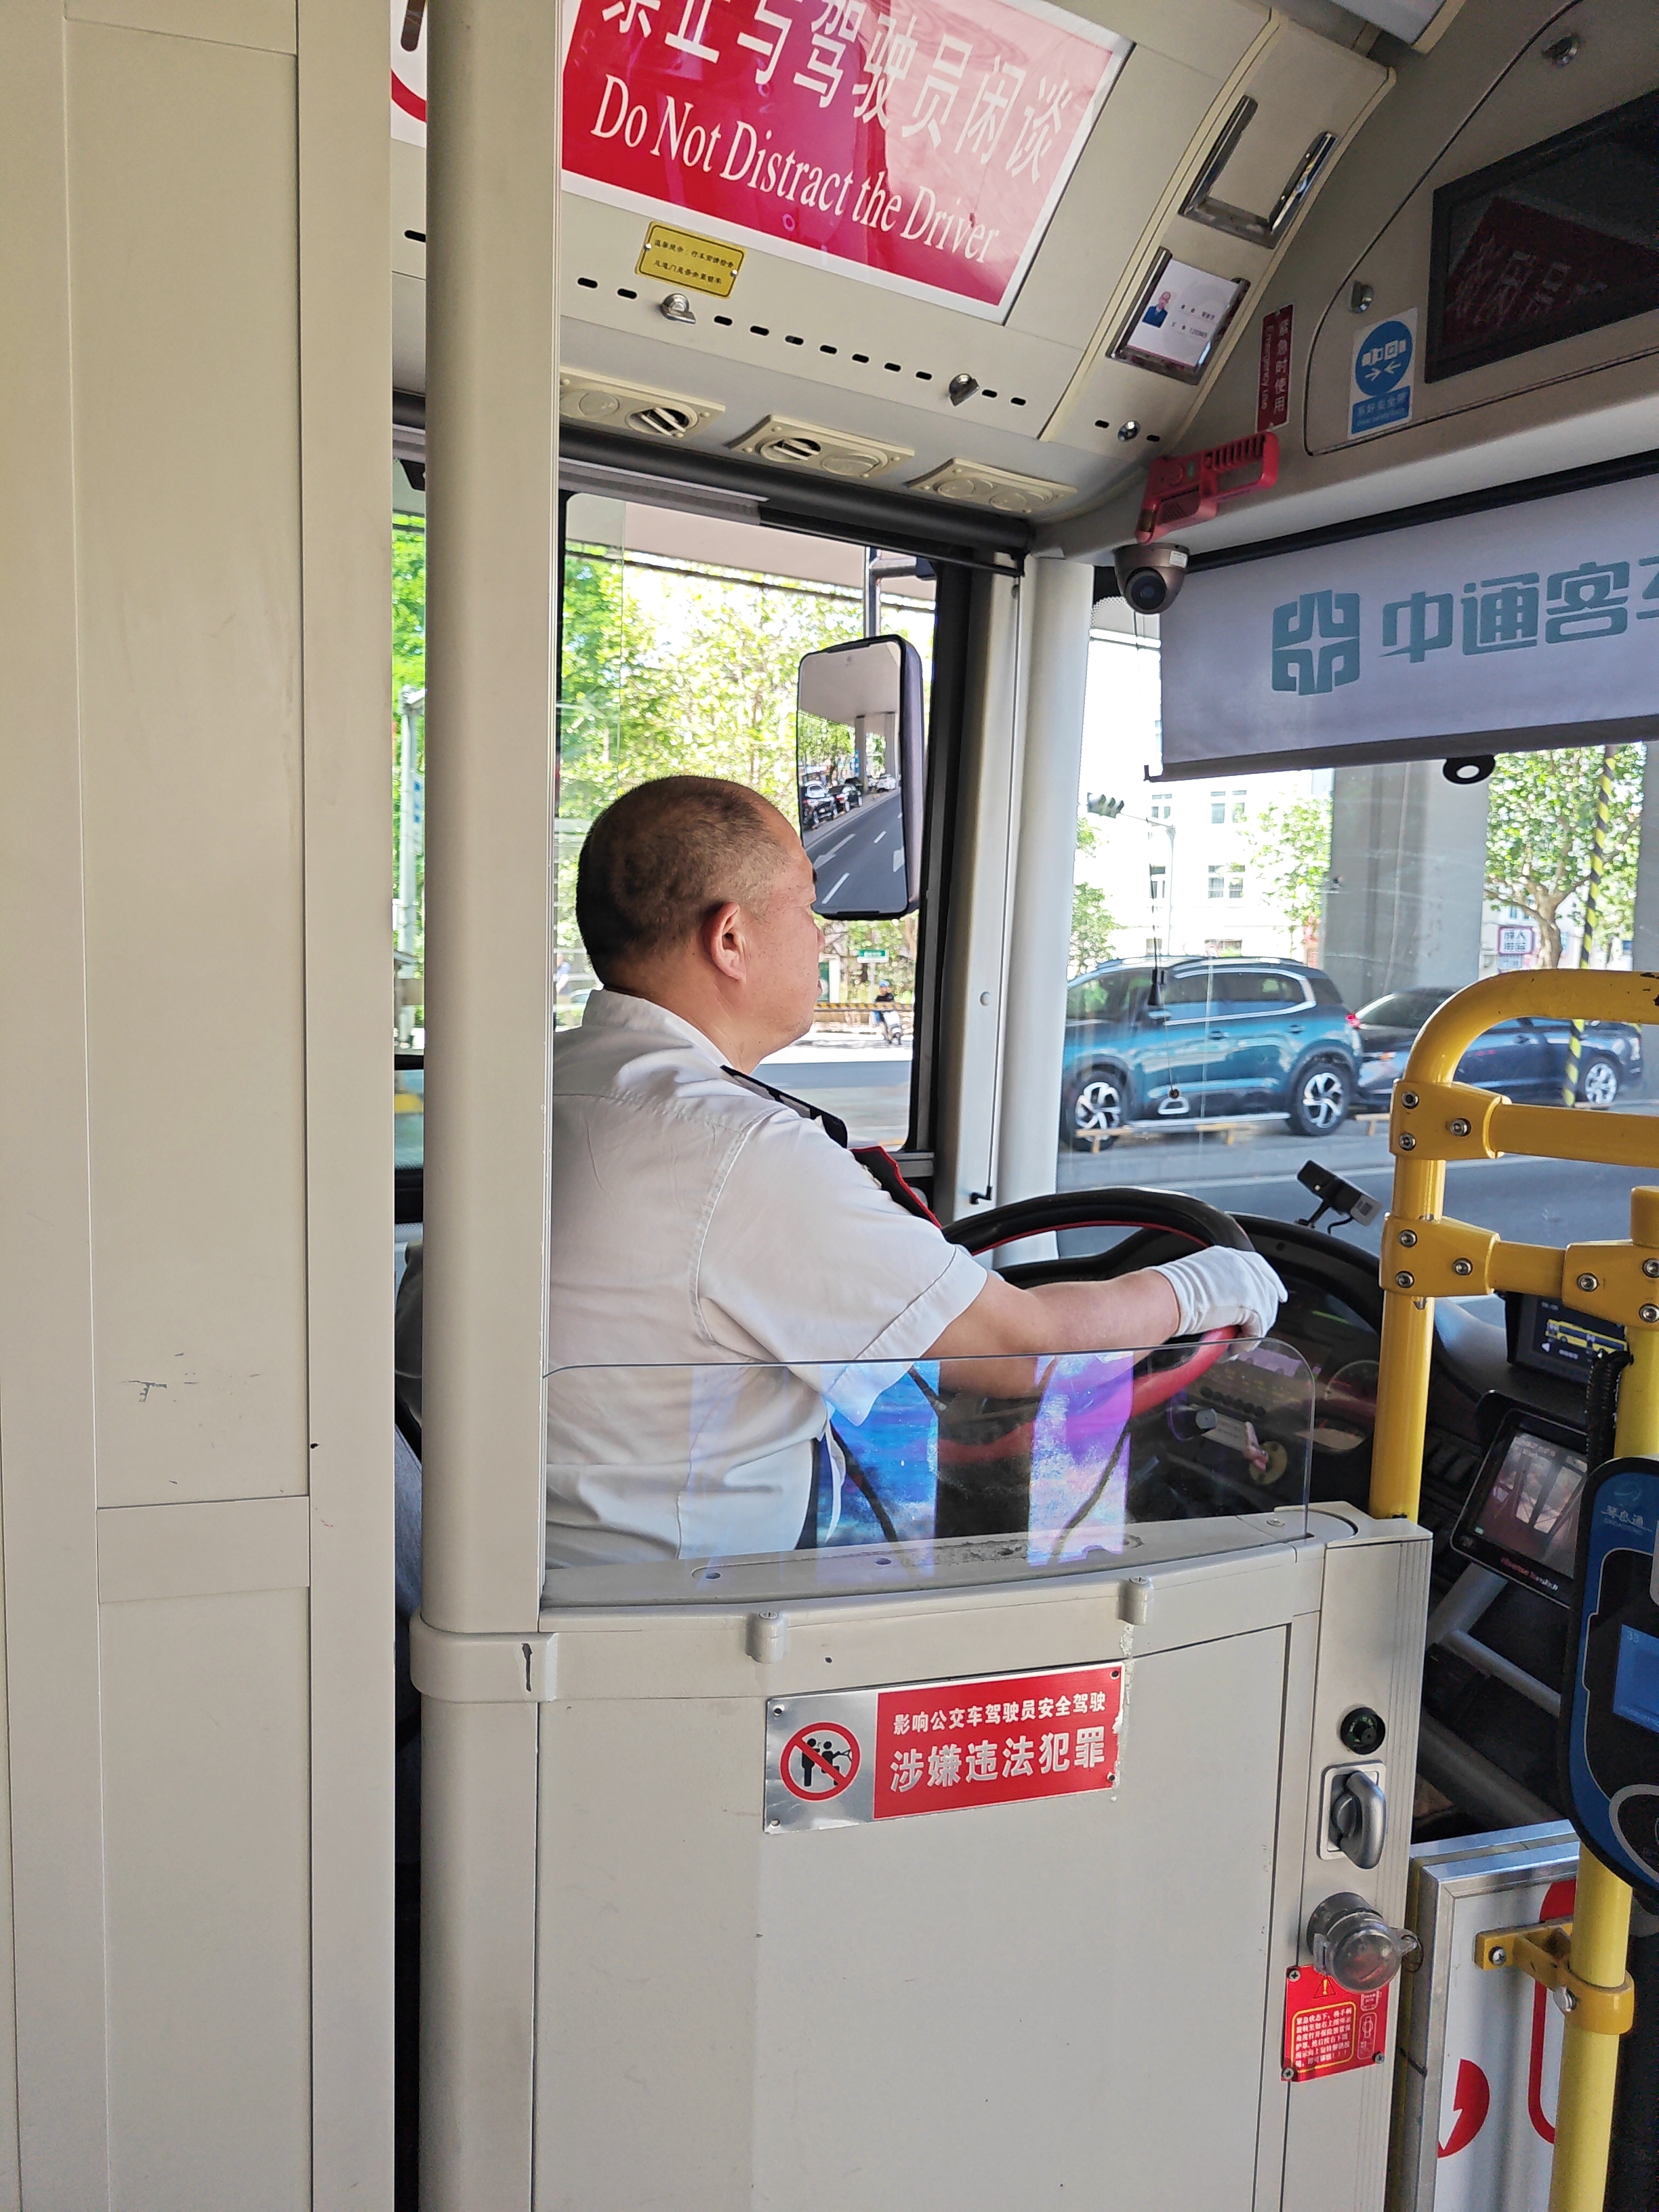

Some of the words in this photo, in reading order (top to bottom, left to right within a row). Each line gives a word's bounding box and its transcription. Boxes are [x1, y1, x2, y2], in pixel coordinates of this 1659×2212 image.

[590, 74, 647, 147] Do
[650, 95, 721, 172] Not
[719, 120, 853, 216] Distract
[852, 171, 902, 232] the
[899, 186, 1000, 263] Driver
[893, 1690, 1106, 1736] 影响公交车驾驶员安全驾驶
[890, 1725, 1105, 1794] 涉嫌违法犯罪
